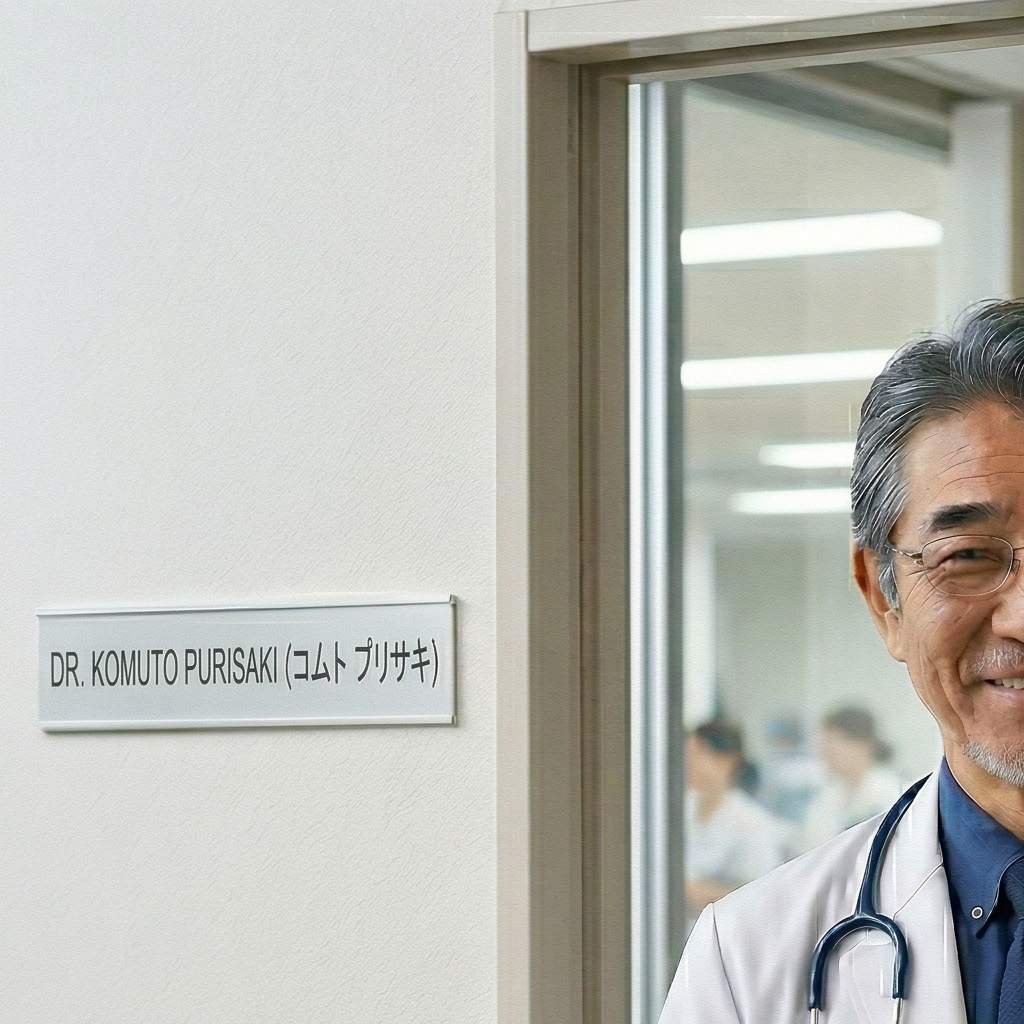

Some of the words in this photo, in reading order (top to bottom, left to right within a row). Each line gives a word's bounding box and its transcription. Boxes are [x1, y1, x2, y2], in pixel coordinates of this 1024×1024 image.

[51, 651, 85, 687] DR.
[92, 648, 179, 687] KOMUTO
[184, 646, 278, 685] PURISAKI
[285, 641, 347, 691] (コムト
[354, 636, 439, 688] プリサキ)
